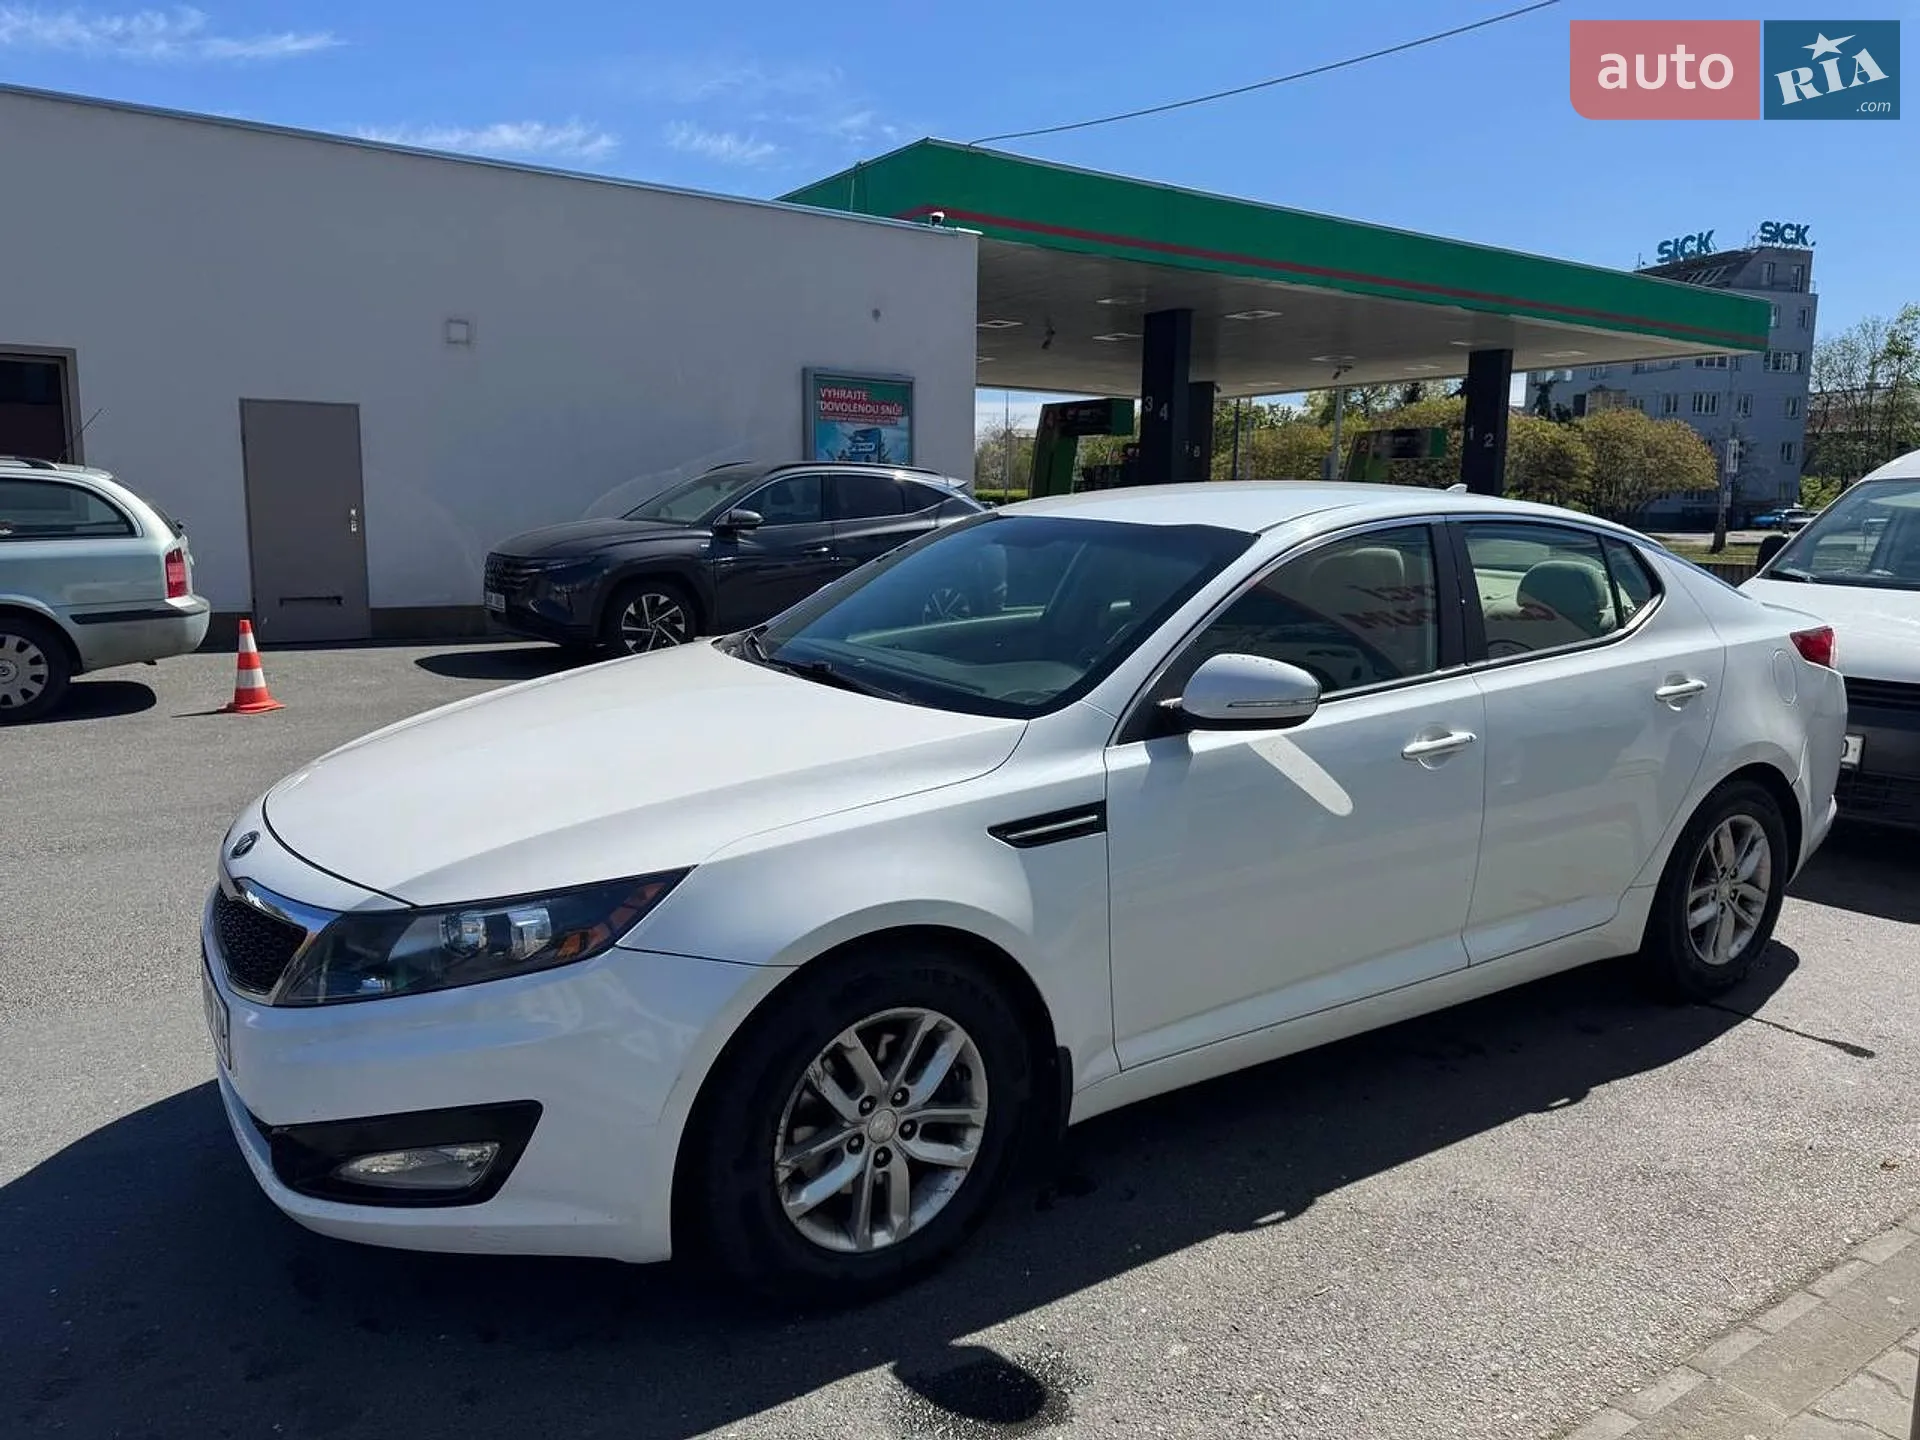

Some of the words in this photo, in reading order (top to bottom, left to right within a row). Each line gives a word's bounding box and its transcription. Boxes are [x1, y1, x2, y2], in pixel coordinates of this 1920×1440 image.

[1760, 221, 1810, 246] SICK
[1656, 229, 1714, 263] SICK
[820, 400, 879, 414] DOVOLENOU
[1144, 396, 1154, 412] 3
[1159, 403, 1169, 420] 4
[1483, 433, 1494, 448] 2
